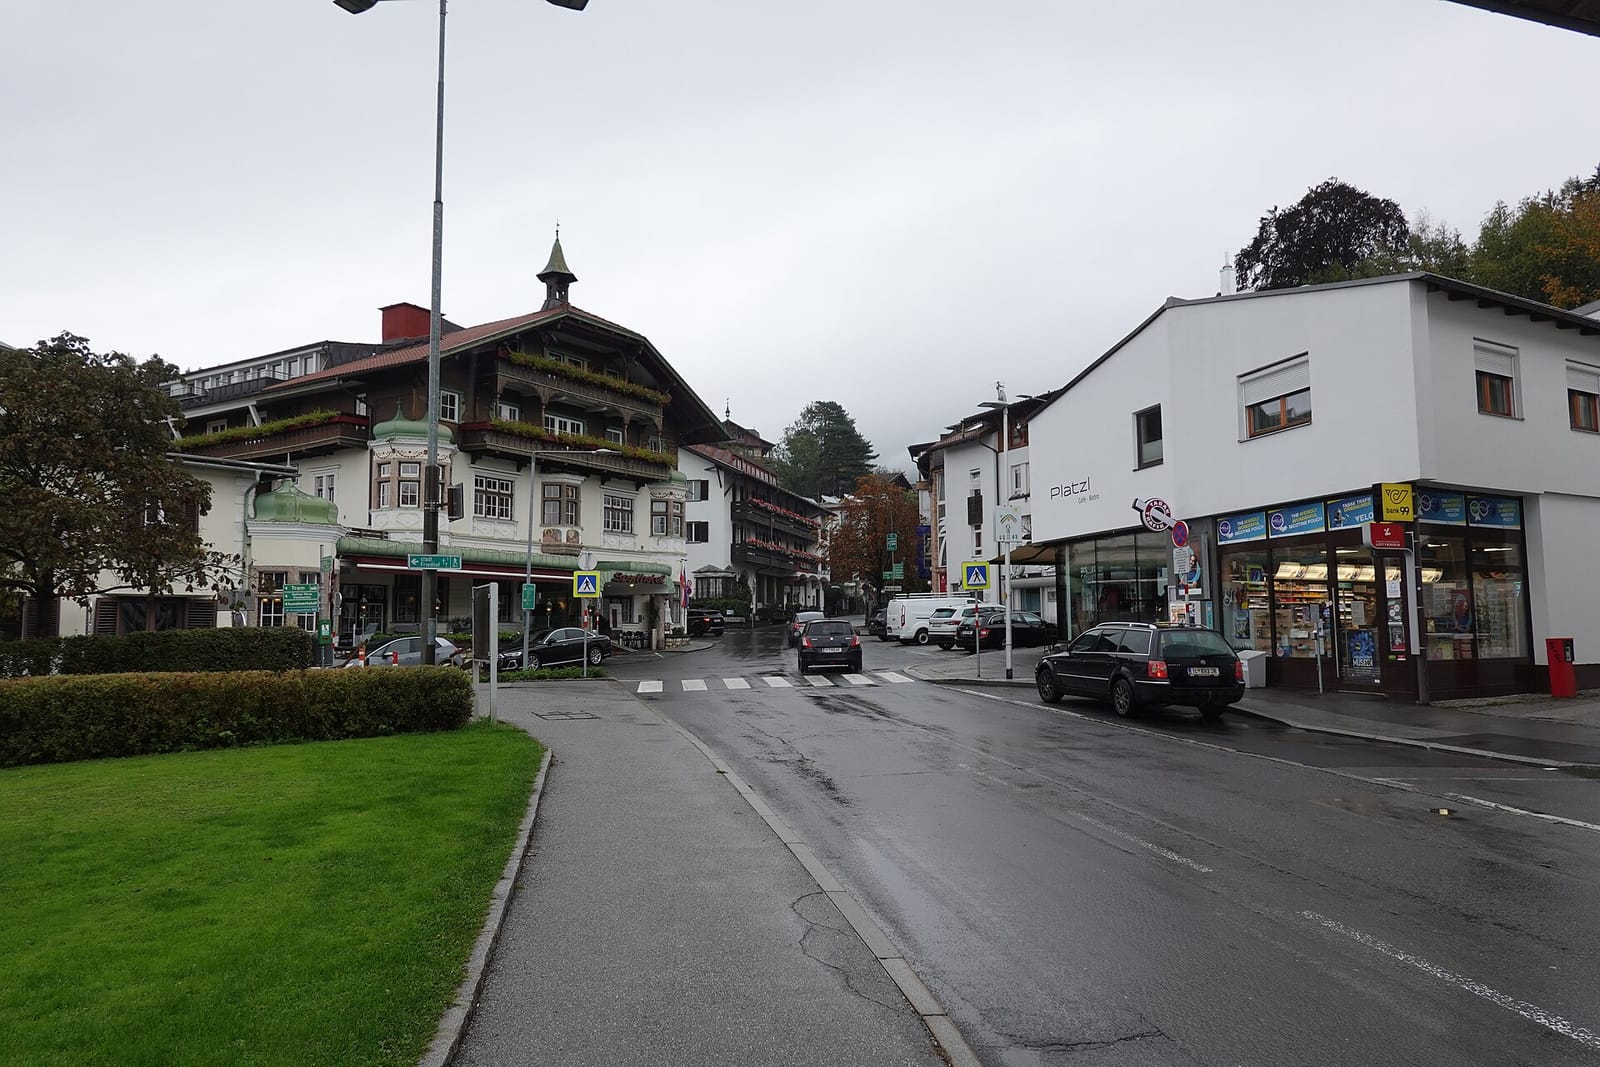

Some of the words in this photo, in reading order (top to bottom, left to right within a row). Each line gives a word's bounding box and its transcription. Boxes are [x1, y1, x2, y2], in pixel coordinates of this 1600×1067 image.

[1050, 476, 1091, 501] Platzl
[1307, 517, 1323, 525] POUCH
[1354, 512, 1374, 522] VELO
